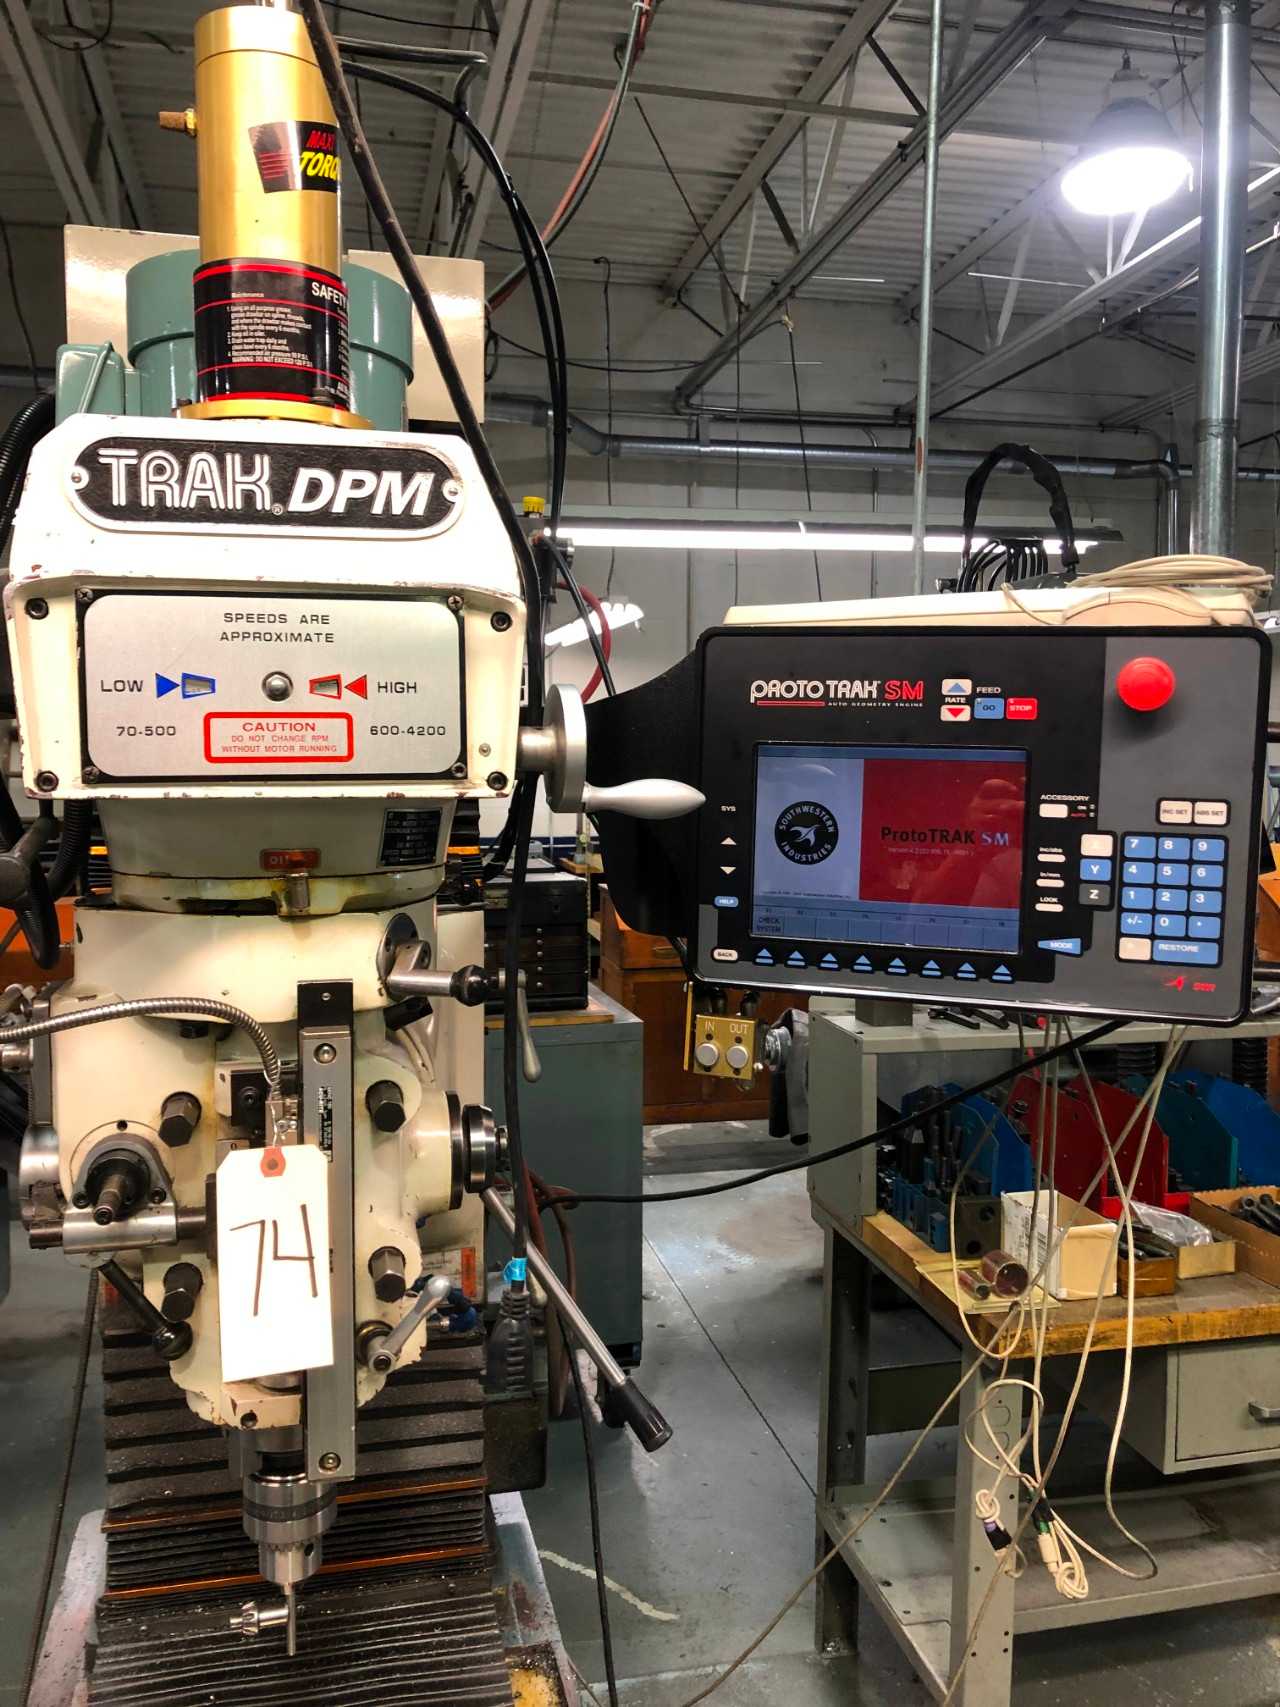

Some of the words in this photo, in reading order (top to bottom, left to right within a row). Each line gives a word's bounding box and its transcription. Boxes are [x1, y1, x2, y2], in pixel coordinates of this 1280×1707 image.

[98, 448, 271, 511] TRAK
[287, 467, 435, 517] DPM
[223, 612, 288, 624] SPEEDS
[299, 614, 331, 625] ARE
[219, 631, 335, 643] APPROXIMATE
[100, 679, 144, 693] LOW
[377, 681, 417, 694] HIGH
[884, 680, 925, 700] SM
[982, 704, 996, 712] GO
[242, 722, 316, 732] CAUTION
[370, 725, 446, 736] 600-4200
[231, 734, 244, 743] DO
[248, 734, 265, 742] NOT
[271, 735, 306, 743] CHANGE
[221, 745, 260, 753] WITHOUT
[264, 745, 295, 753] MOTOR
[1040, 794, 1090, 802] ACCESSORY
[720, 805, 737, 813] SYS
[779, 805, 835, 832] SOUTHWESTERN
[880, 826, 976, 844] ProtoTRAK
[980, 831, 1009, 846] SM
[1130, 839, 1139, 849] 7
[1164, 841, 1174, 850] 8
[1198, 842, 1208, 852] 9
[781, 841, 832, 862] INDUSTRIES
[1090, 864, 1100, 875] Y
[1128, 865, 1138, 875] 4
[1162, 866, 1172, 876] 5
[1196, 868, 1207, 878] 6
[1089, 889, 1100, 900] Z
[1129, 891, 1136, 900] 1
[1161, 892, 1171, 902] 2
[1195, 894, 1206, 904] 3
[758, 916, 781, 924] CHECK
[1160, 918, 1169, 927] 0
[757, 925, 782, 933] SYSTEM
[1050, 942, 1073, 950] MODE
[1158, 944, 1199, 953] RESTORE
[717, 950, 734, 958] BACK
[705, 1021, 715, 1031] IN
[729, 1023, 748, 1033] OUT
[229, 1204, 318, 1317] 74
